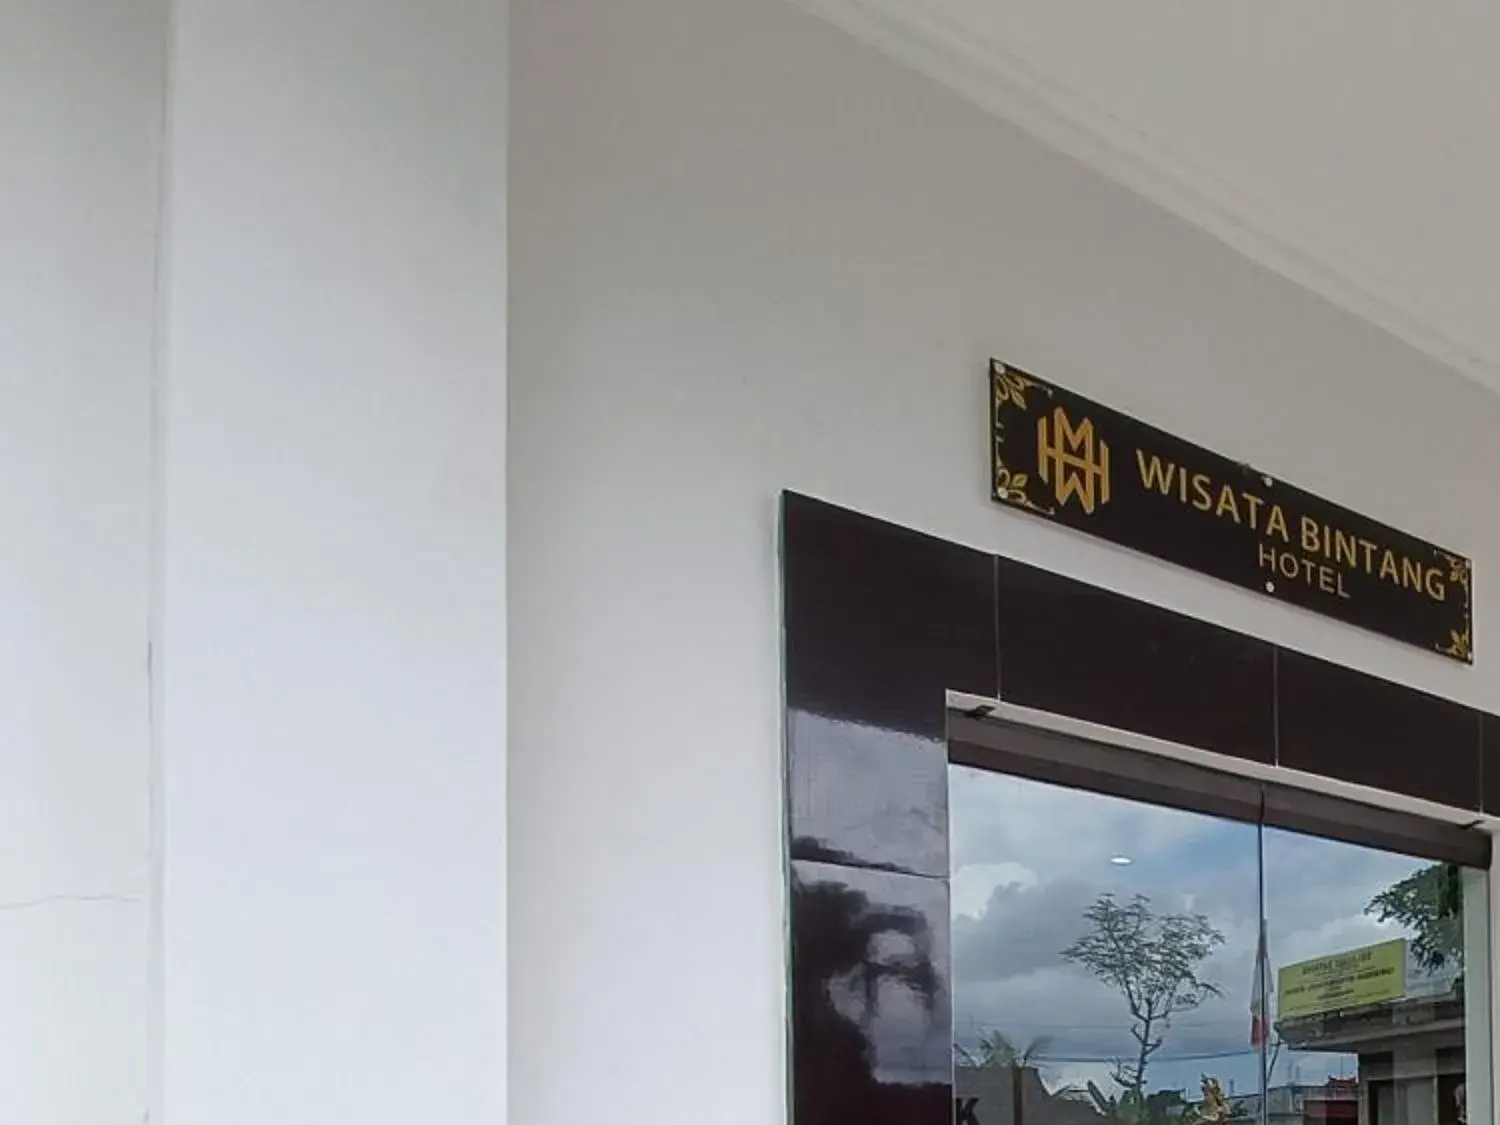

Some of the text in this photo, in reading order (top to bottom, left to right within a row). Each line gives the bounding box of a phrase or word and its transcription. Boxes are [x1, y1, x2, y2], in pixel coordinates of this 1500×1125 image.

[1135, 448, 1445, 601] WISATA BINTANG
[1259, 543, 1350, 600] HOTEL
